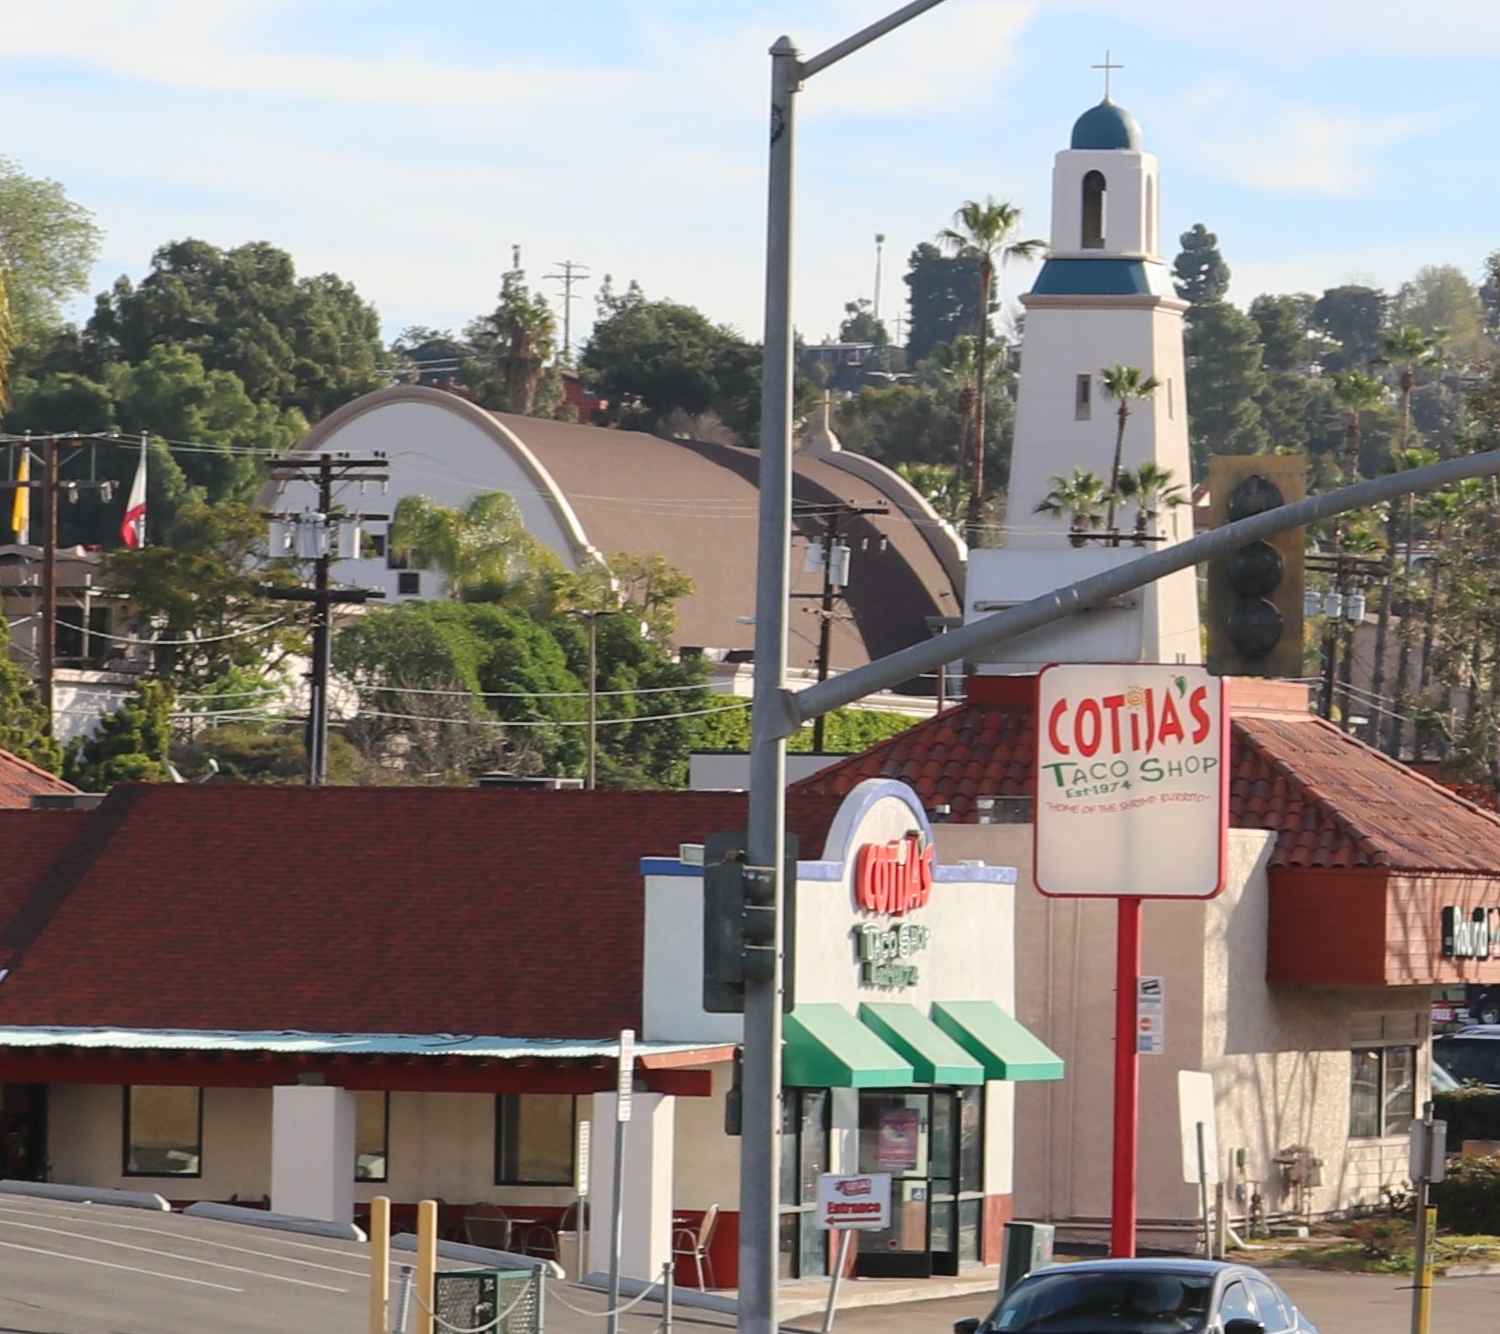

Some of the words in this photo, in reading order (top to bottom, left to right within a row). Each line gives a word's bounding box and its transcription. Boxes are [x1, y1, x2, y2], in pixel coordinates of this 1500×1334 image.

[1041, 760, 1129, 787] TACO
[1140, 756, 1218, 782] SHOP
[1453, 906, 1488, 957] Round
